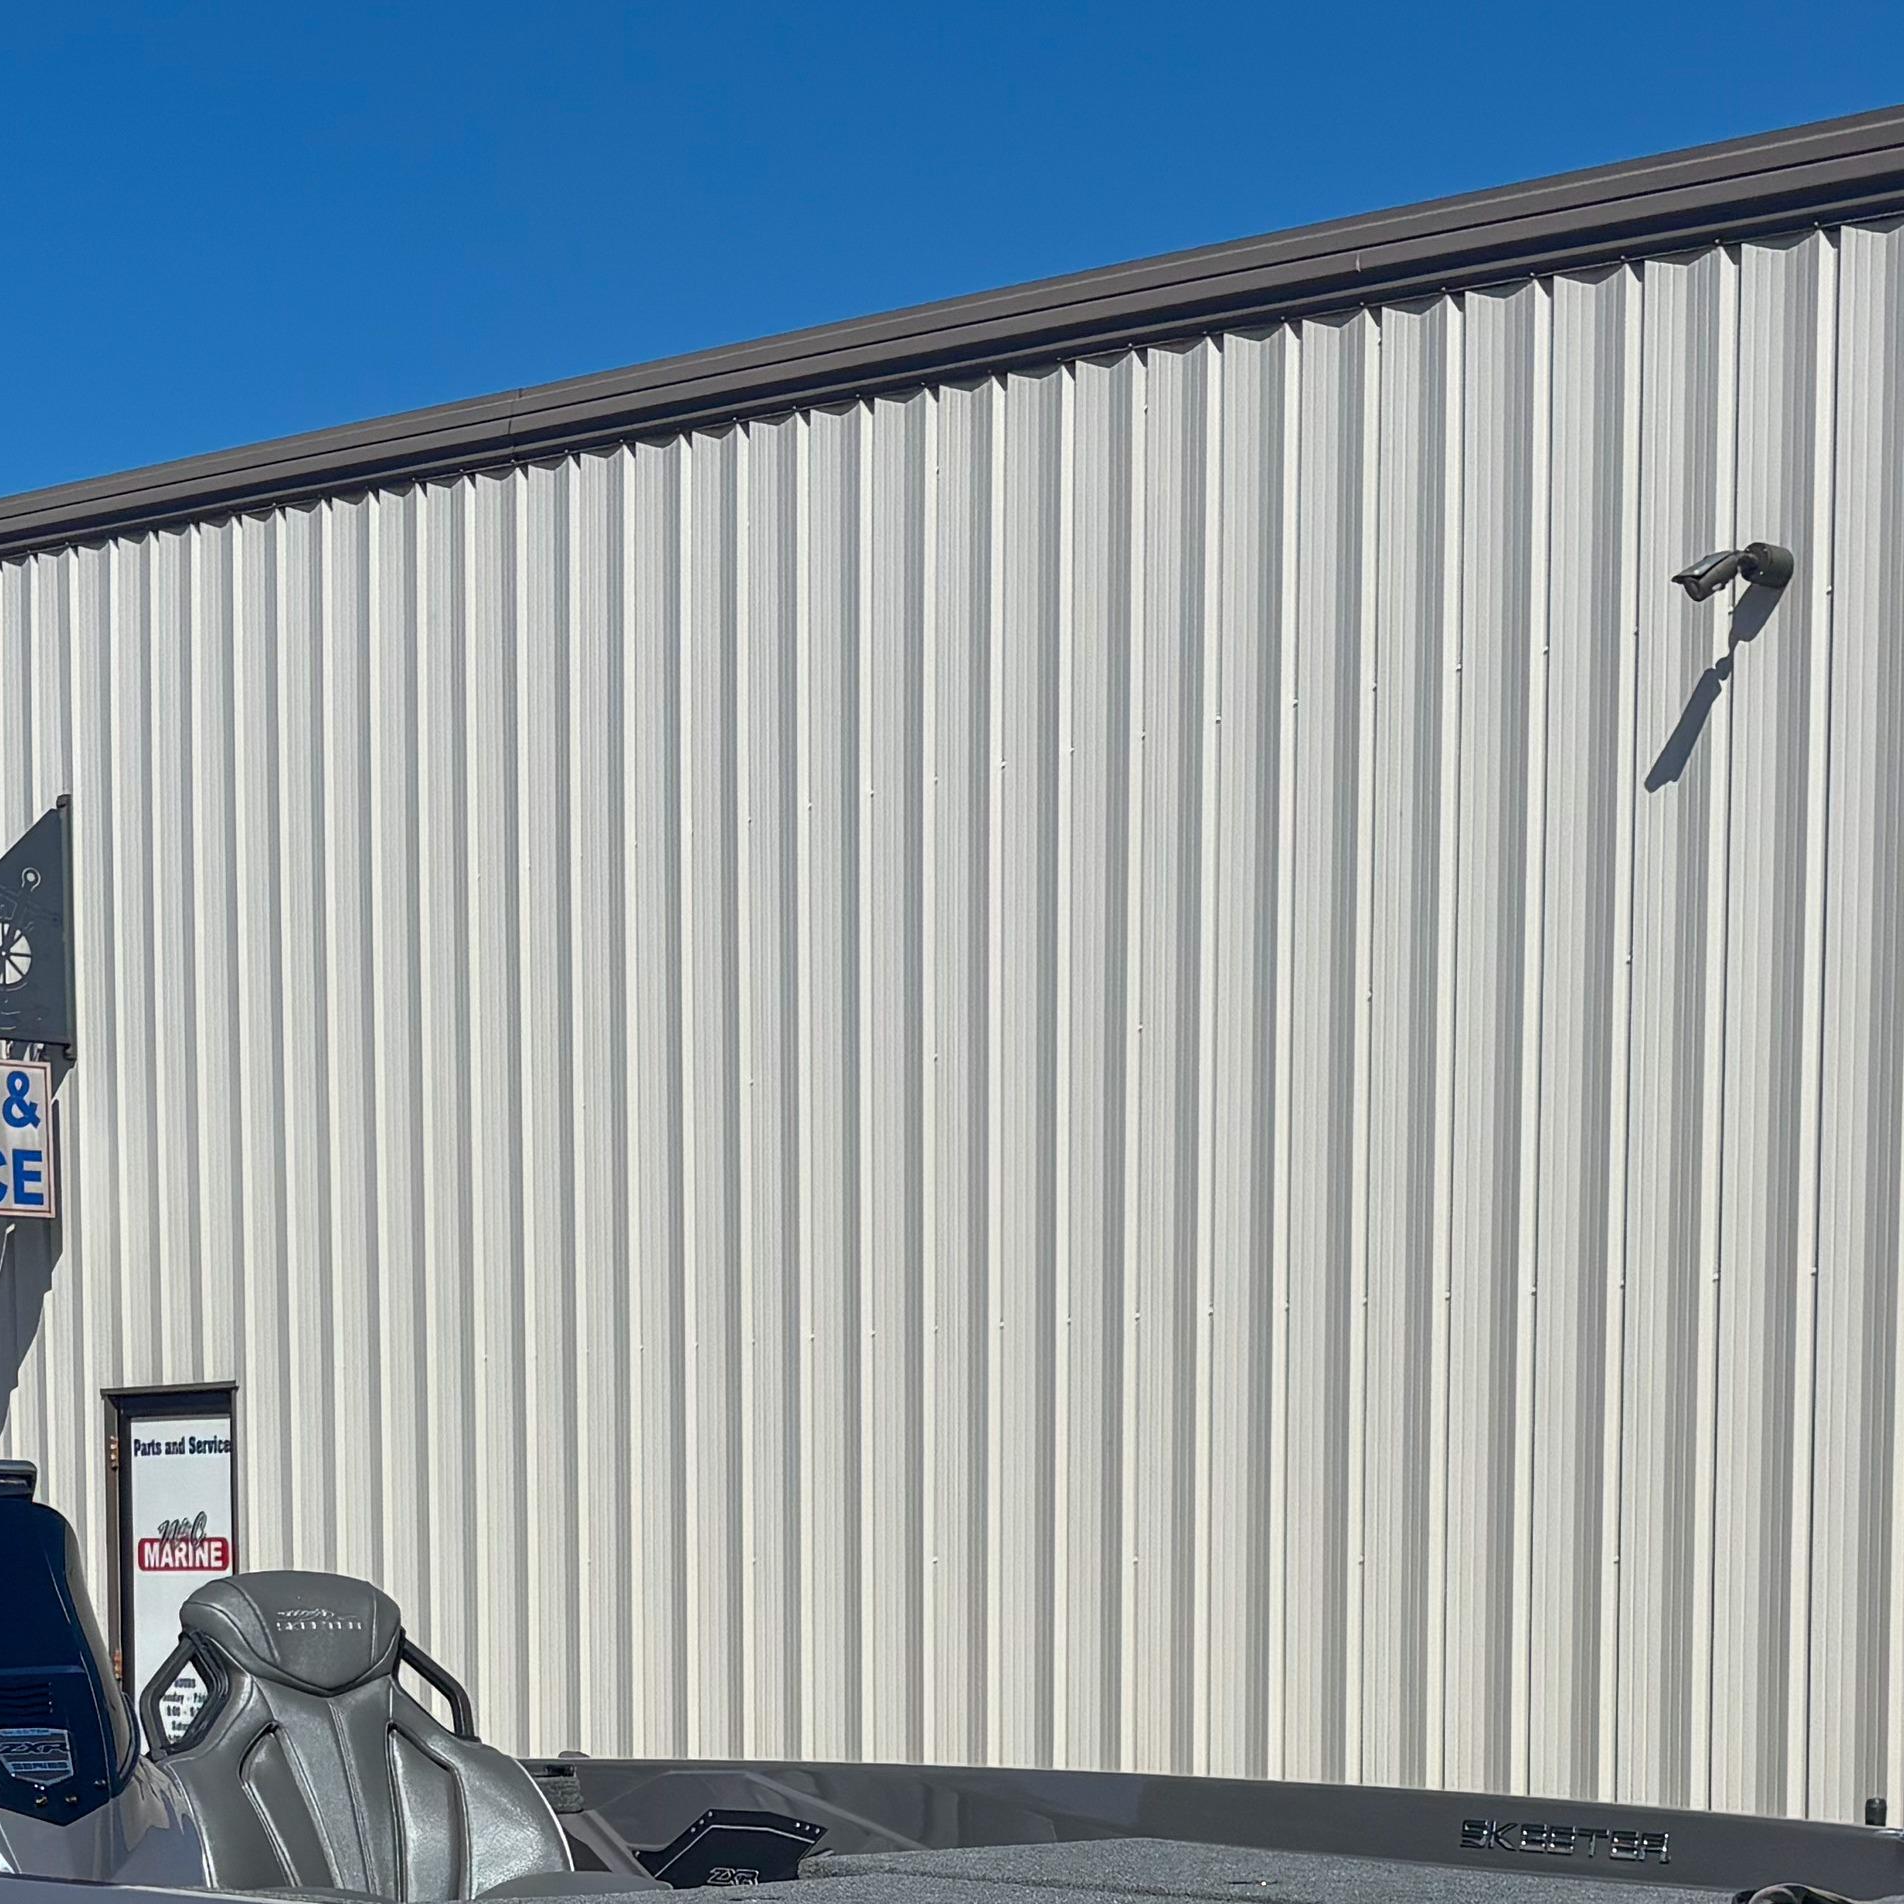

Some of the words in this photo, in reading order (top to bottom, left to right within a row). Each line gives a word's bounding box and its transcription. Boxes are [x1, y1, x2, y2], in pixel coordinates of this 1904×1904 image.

[2, 1070, 41, 1129] &
[133, 1438, 163, 1457] Parts
[165, 1436, 186, 1455] and
[188, 1435, 233, 1455] Service
[144, 1540, 223, 1568] MARINE
[1459, 1818, 1672, 1865] SKEETER
